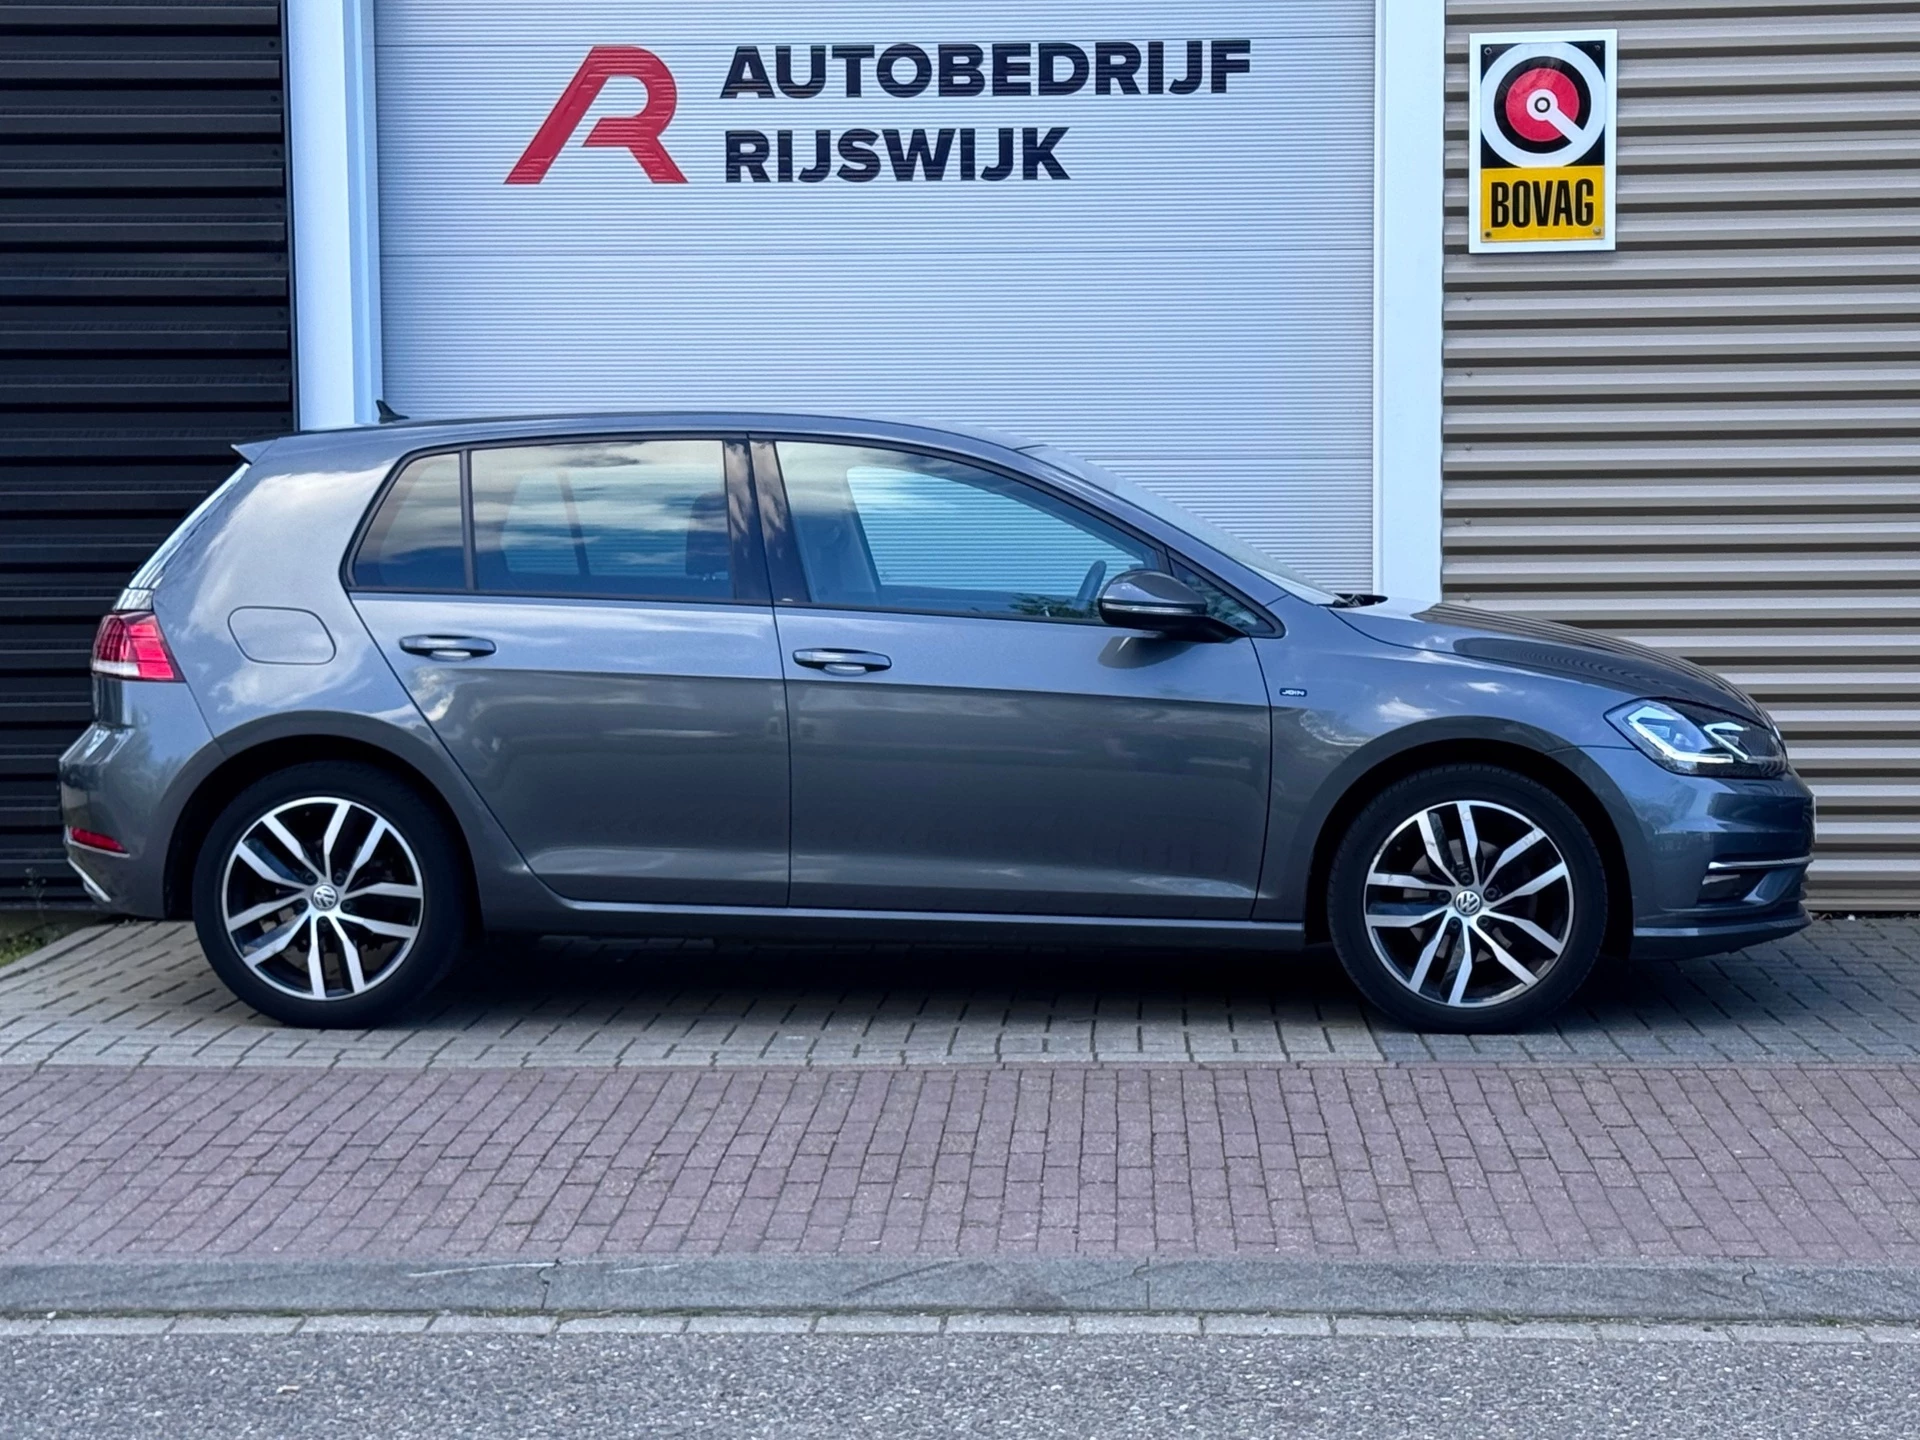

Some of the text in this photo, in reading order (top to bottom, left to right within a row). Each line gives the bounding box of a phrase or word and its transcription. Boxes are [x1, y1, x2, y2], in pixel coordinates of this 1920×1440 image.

[720, 39, 1251, 99] AUTOBEDRIJF
[725, 126, 1071, 183] RIJSWIJK
[1491, 178, 1595, 228] BOVAG
